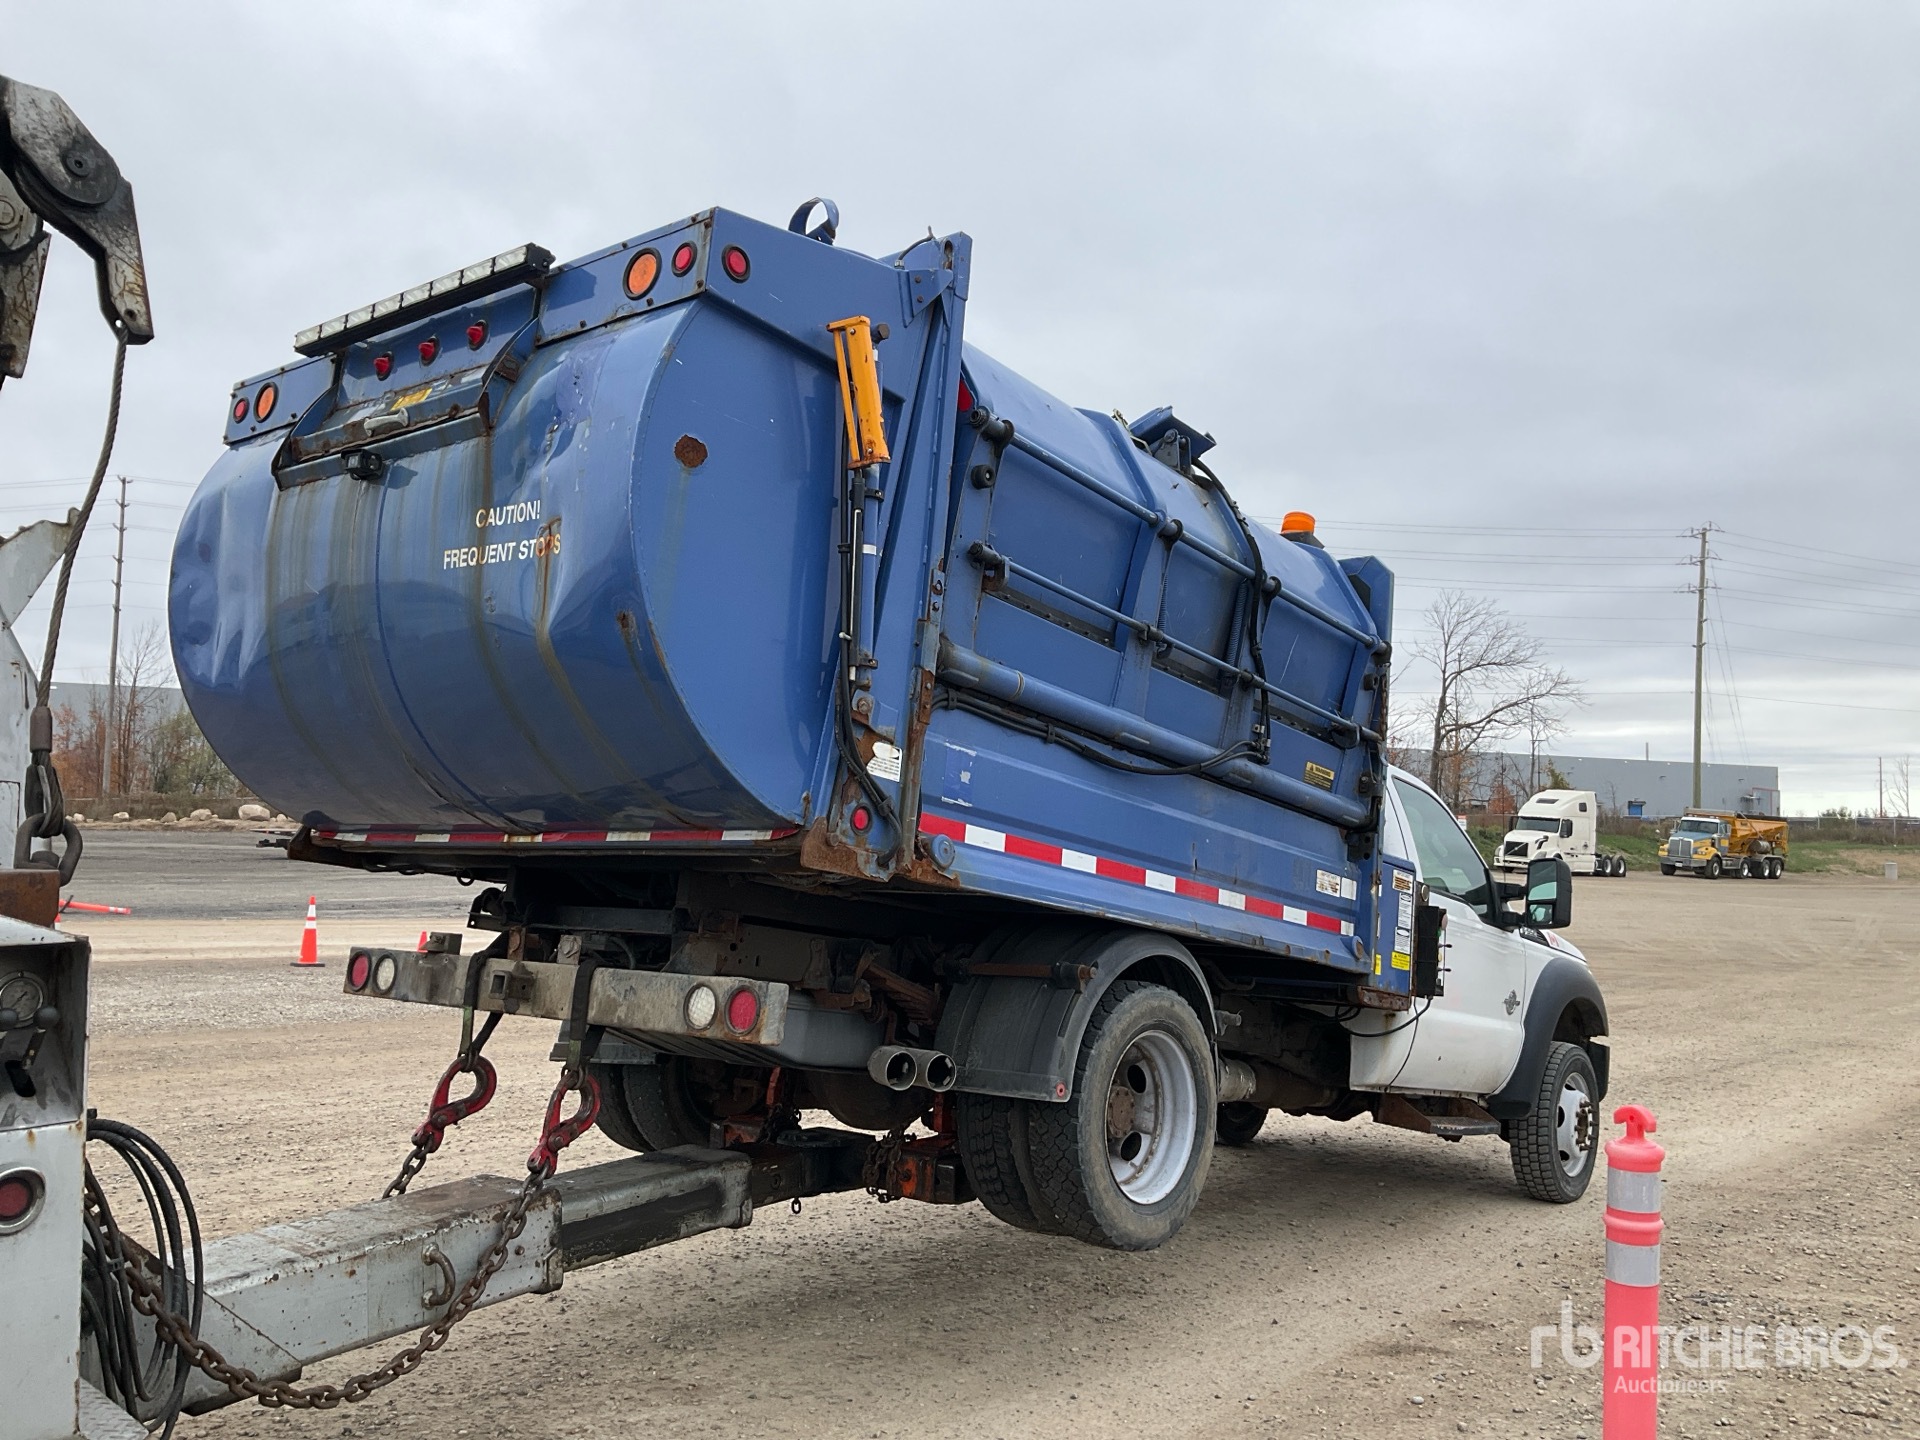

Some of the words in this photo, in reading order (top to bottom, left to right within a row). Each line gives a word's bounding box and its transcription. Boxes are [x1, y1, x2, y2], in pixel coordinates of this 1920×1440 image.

[476, 500, 541, 528] CAUTION!
[443, 542, 516, 570] FREQUENT
[518, 533, 561, 560] STOPS
